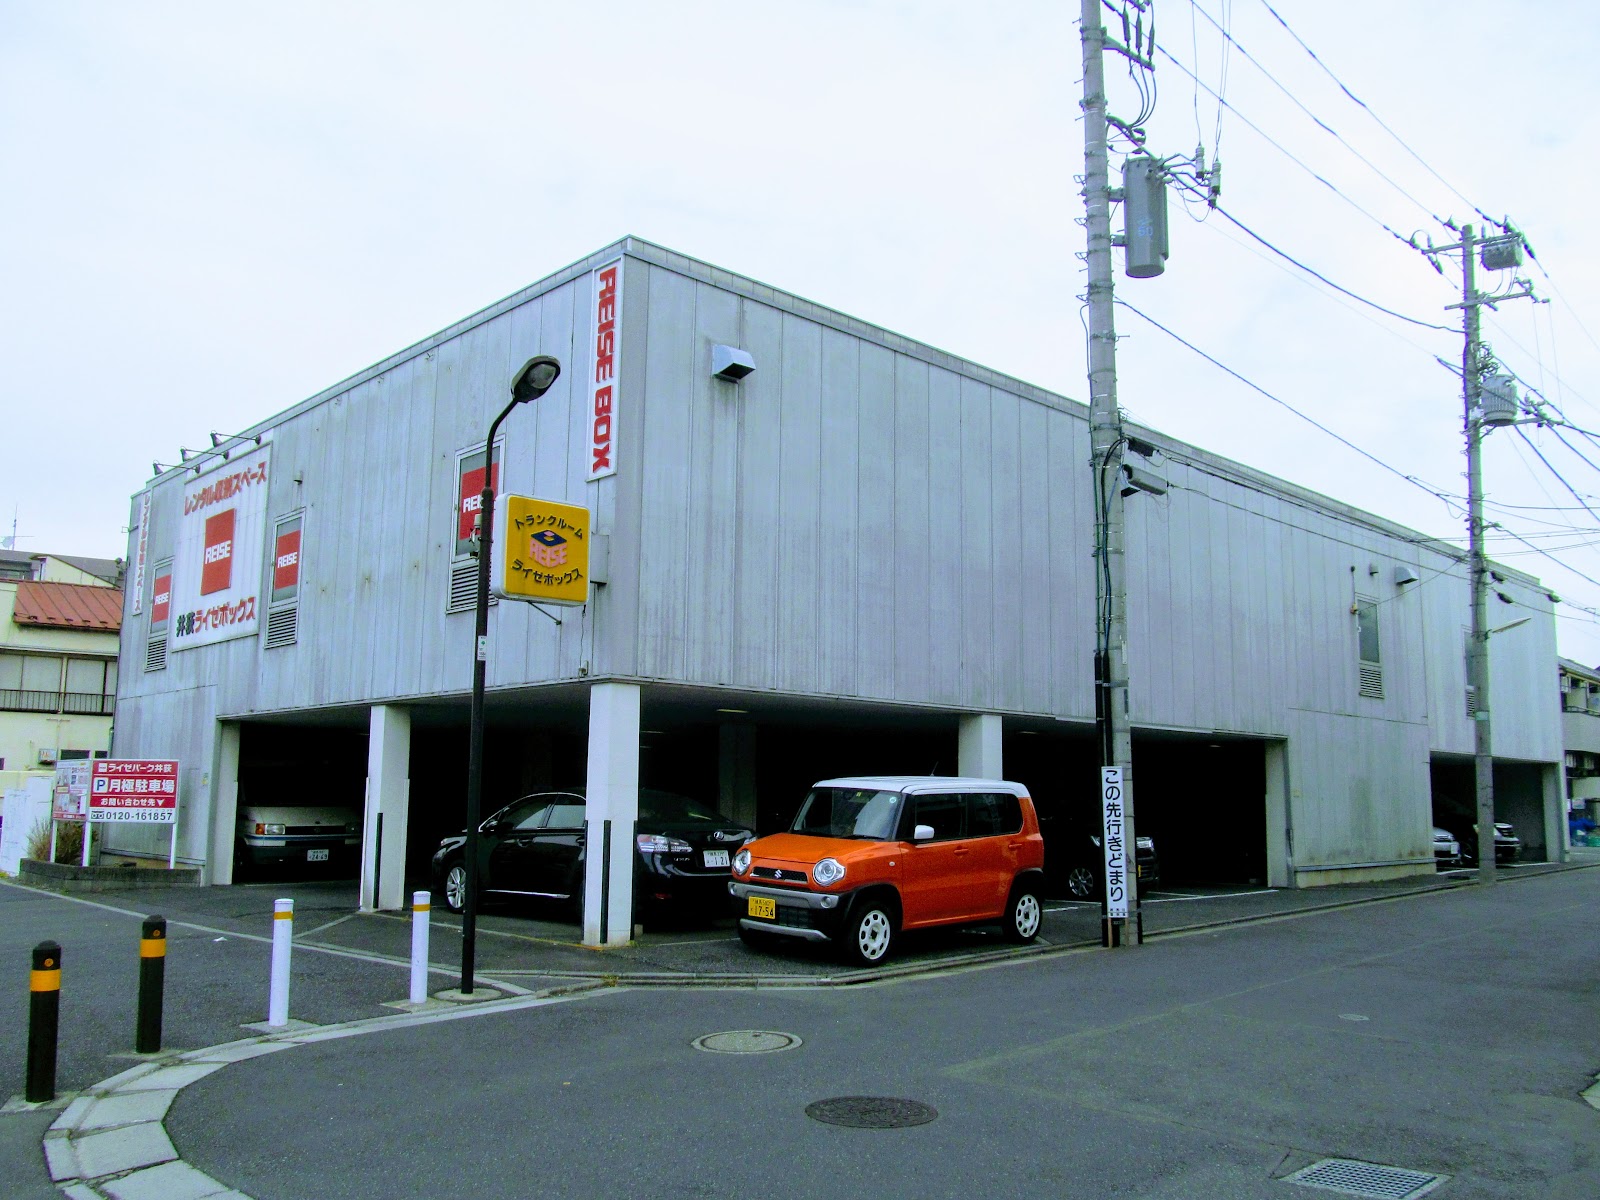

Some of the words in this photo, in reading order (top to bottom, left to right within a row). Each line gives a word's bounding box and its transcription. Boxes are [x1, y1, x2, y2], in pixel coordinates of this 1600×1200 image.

[596, 267, 616, 383] REISE
[592, 385, 612, 473] BOX
[515, 514, 583, 540] トランクルーム
[204, 540, 231, 564] REISE
[277, 552, 297, 568] REISE
[529, 538, 567, 568] REISE
[511, 558, 584, 585] ライゼボックス
[96, 779, 106, 791] P
[109, 778, 175, 793] 月極駐車場
[100, 798, 156, 807] お問い合わせ先
[105, 811, 173, 821] 0120-161857
[1105, 769, 1123, 902] この先行きどまり
